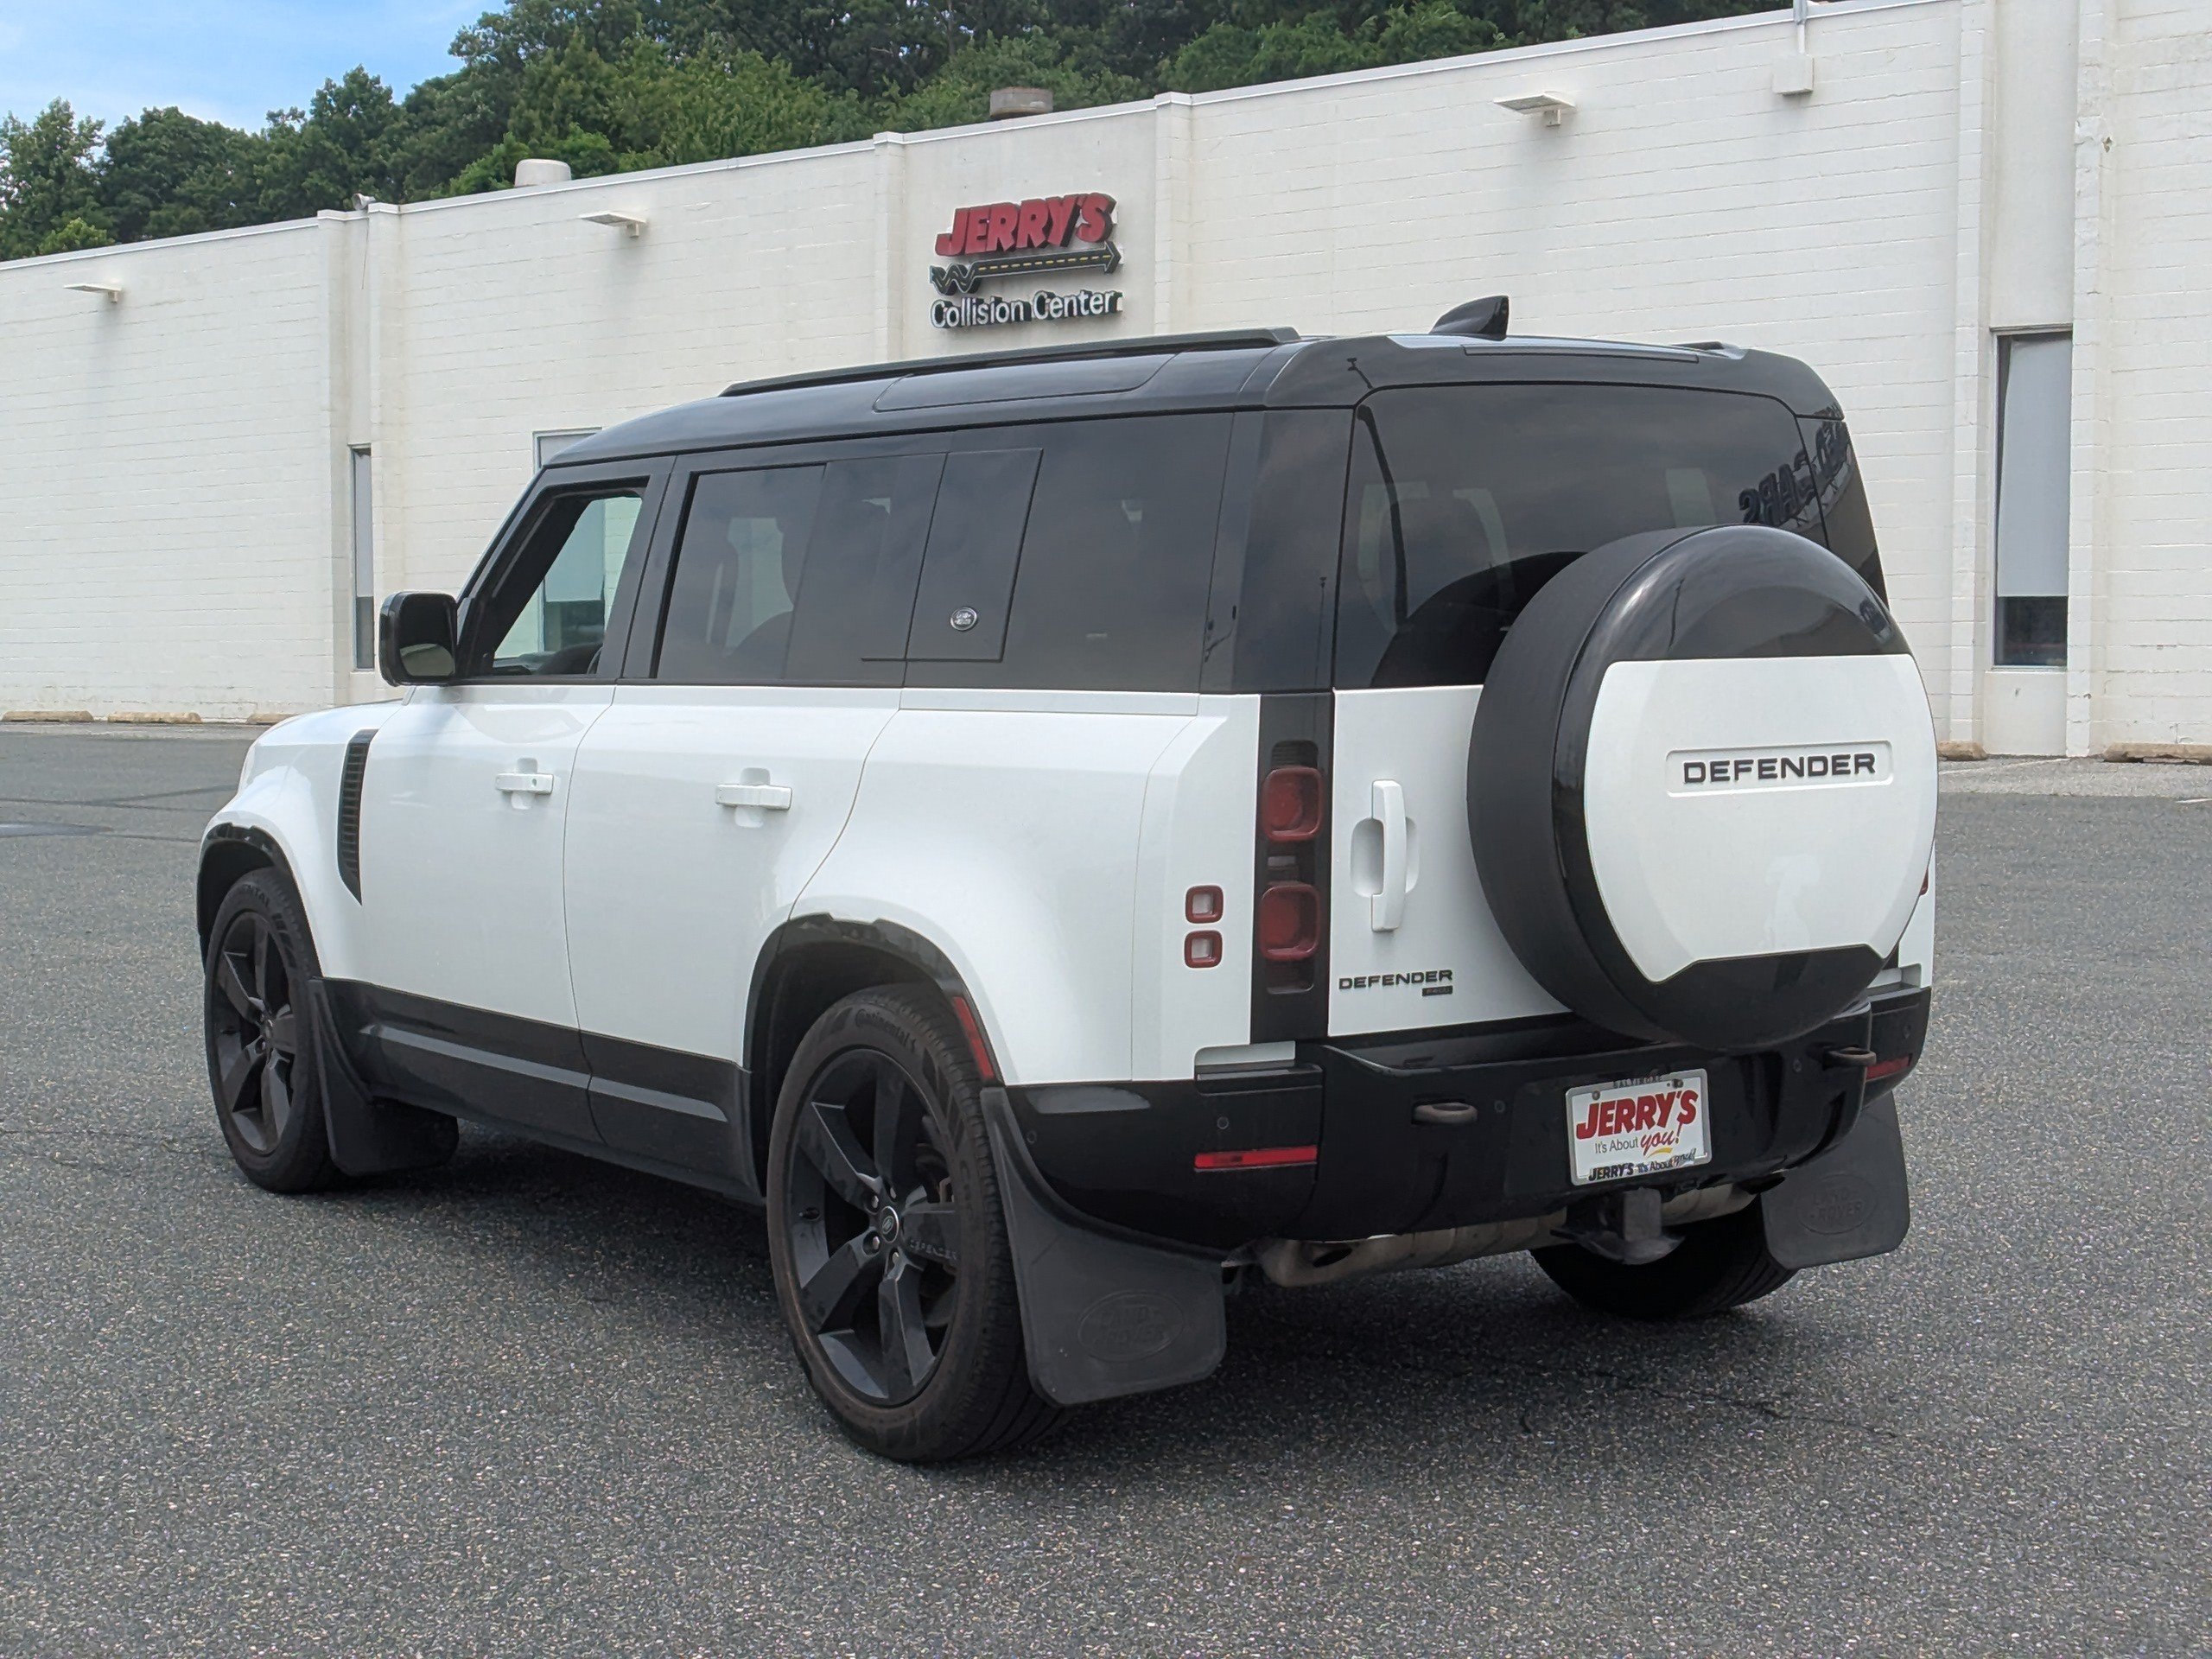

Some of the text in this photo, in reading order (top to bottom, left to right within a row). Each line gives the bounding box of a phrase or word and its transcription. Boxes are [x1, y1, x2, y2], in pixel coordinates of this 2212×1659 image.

[935, 193, 1116, 257] JERRY'S
[931, 289, 1122, 328] Collision Center
[1683, 753, 1876, 784] DEFENDER
[1338, 969, 1453, 990] DEFENDER
[1576, 1090, 1699, 1140] JERRY'S
[1595, 1122, 1683, 1156] It's About you!
[1588, 1162, 1635, 1181] JERRY'S
